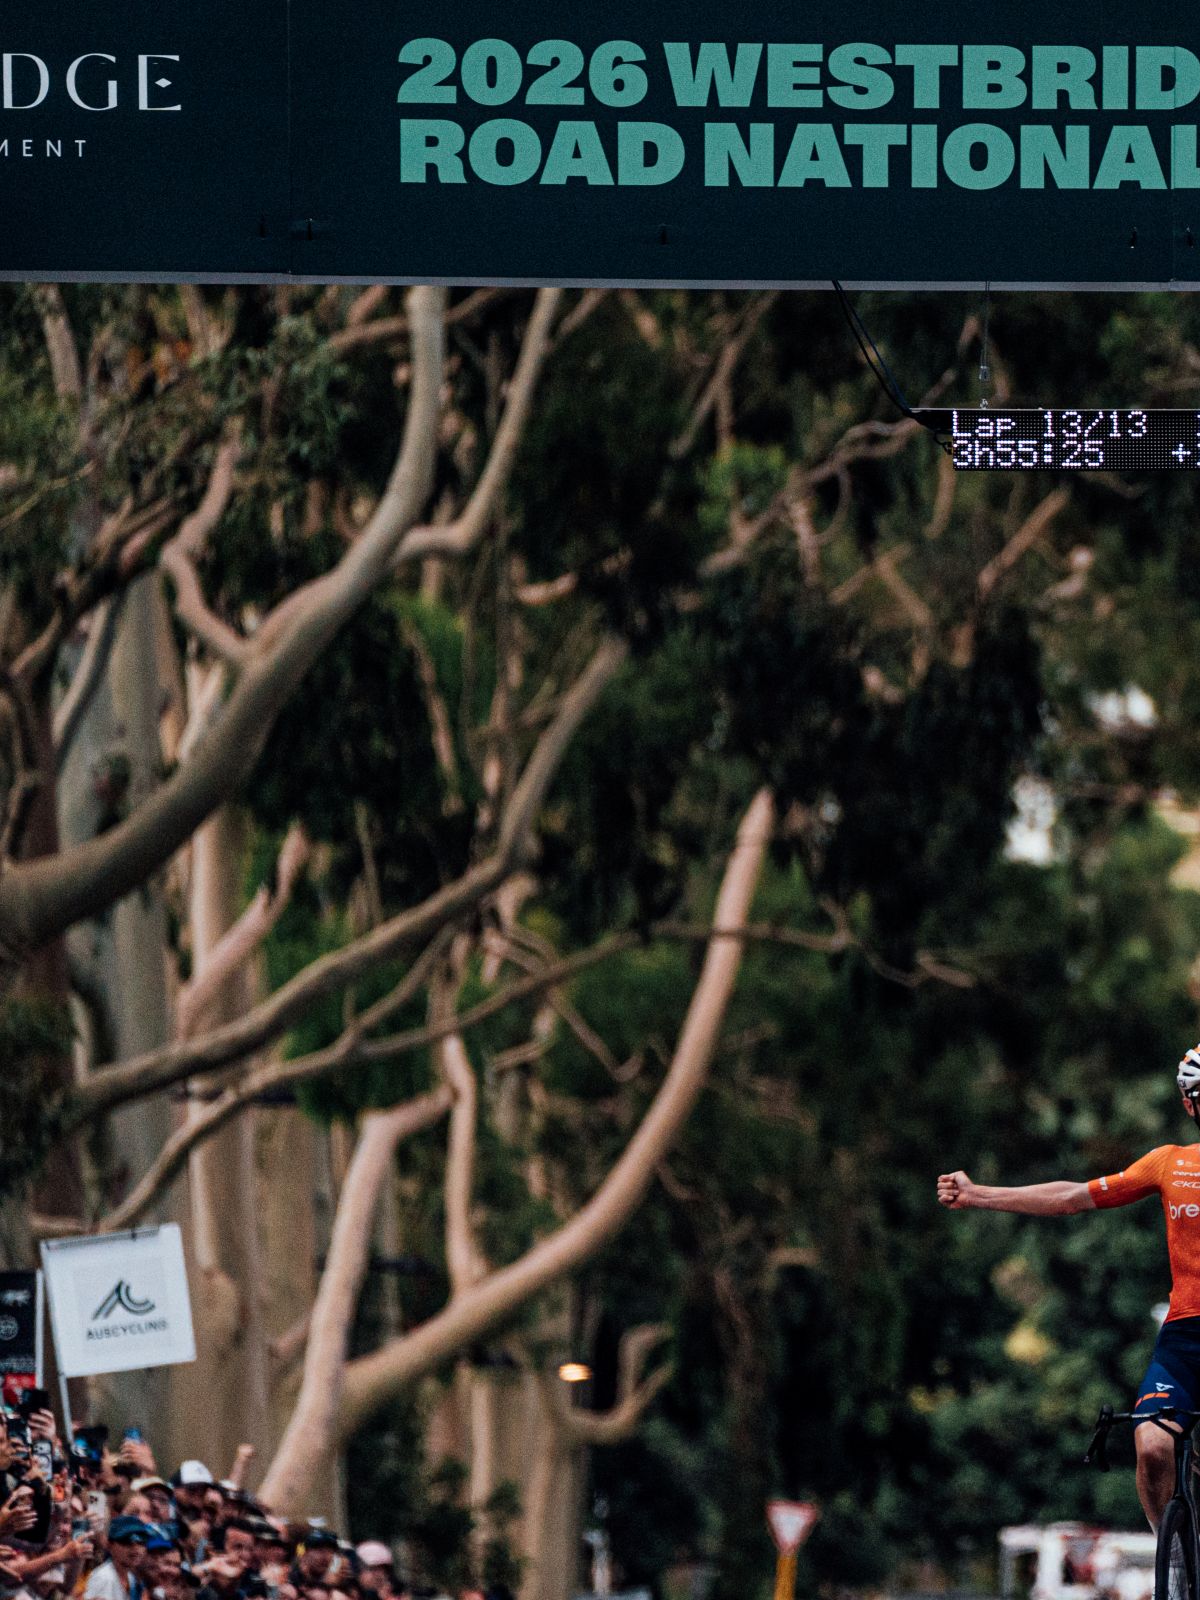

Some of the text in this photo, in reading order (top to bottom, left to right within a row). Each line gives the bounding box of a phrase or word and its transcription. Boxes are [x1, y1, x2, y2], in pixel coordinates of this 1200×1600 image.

[397, 37, 648, 108] 2026
[400, 118, 686, 186] ROAD
[953, 410, 1016, 437] Lap
[1044, 410, 1147, 437] 13/13
[952, 440, 1104, 467] 3h55:25
[86, 1319, 169, 1340] AUSCYCLING
